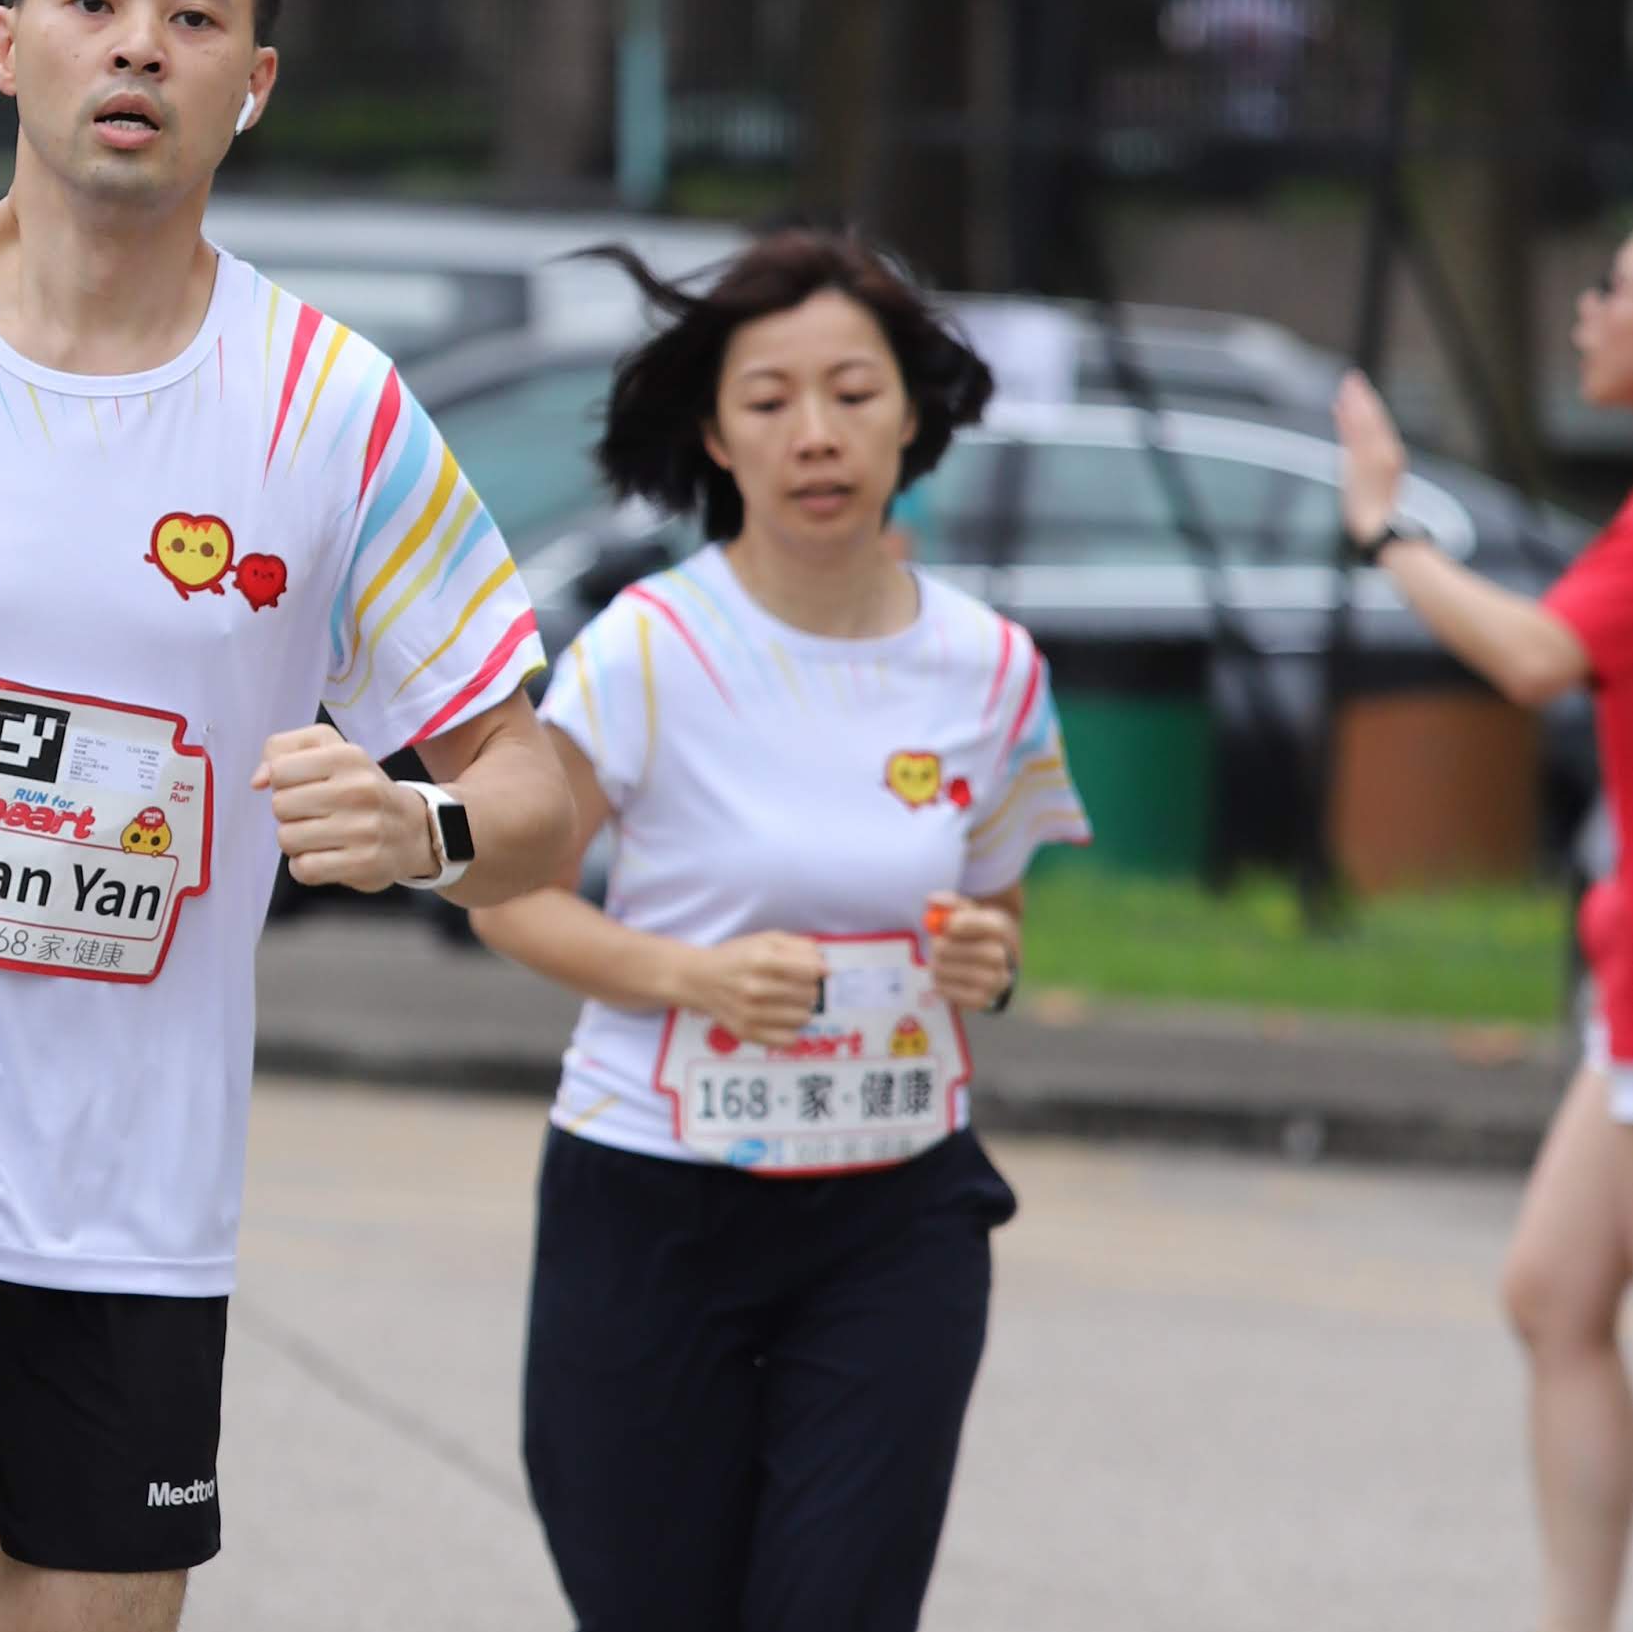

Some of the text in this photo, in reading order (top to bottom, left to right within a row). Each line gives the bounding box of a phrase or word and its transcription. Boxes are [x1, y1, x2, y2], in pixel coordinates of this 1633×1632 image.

[171, 780, 195, 792] 2km
[14, 787, 75, 810] RUN for
[169, 792, 191, 804] Run
[72, 863, 162, 922] Yan
